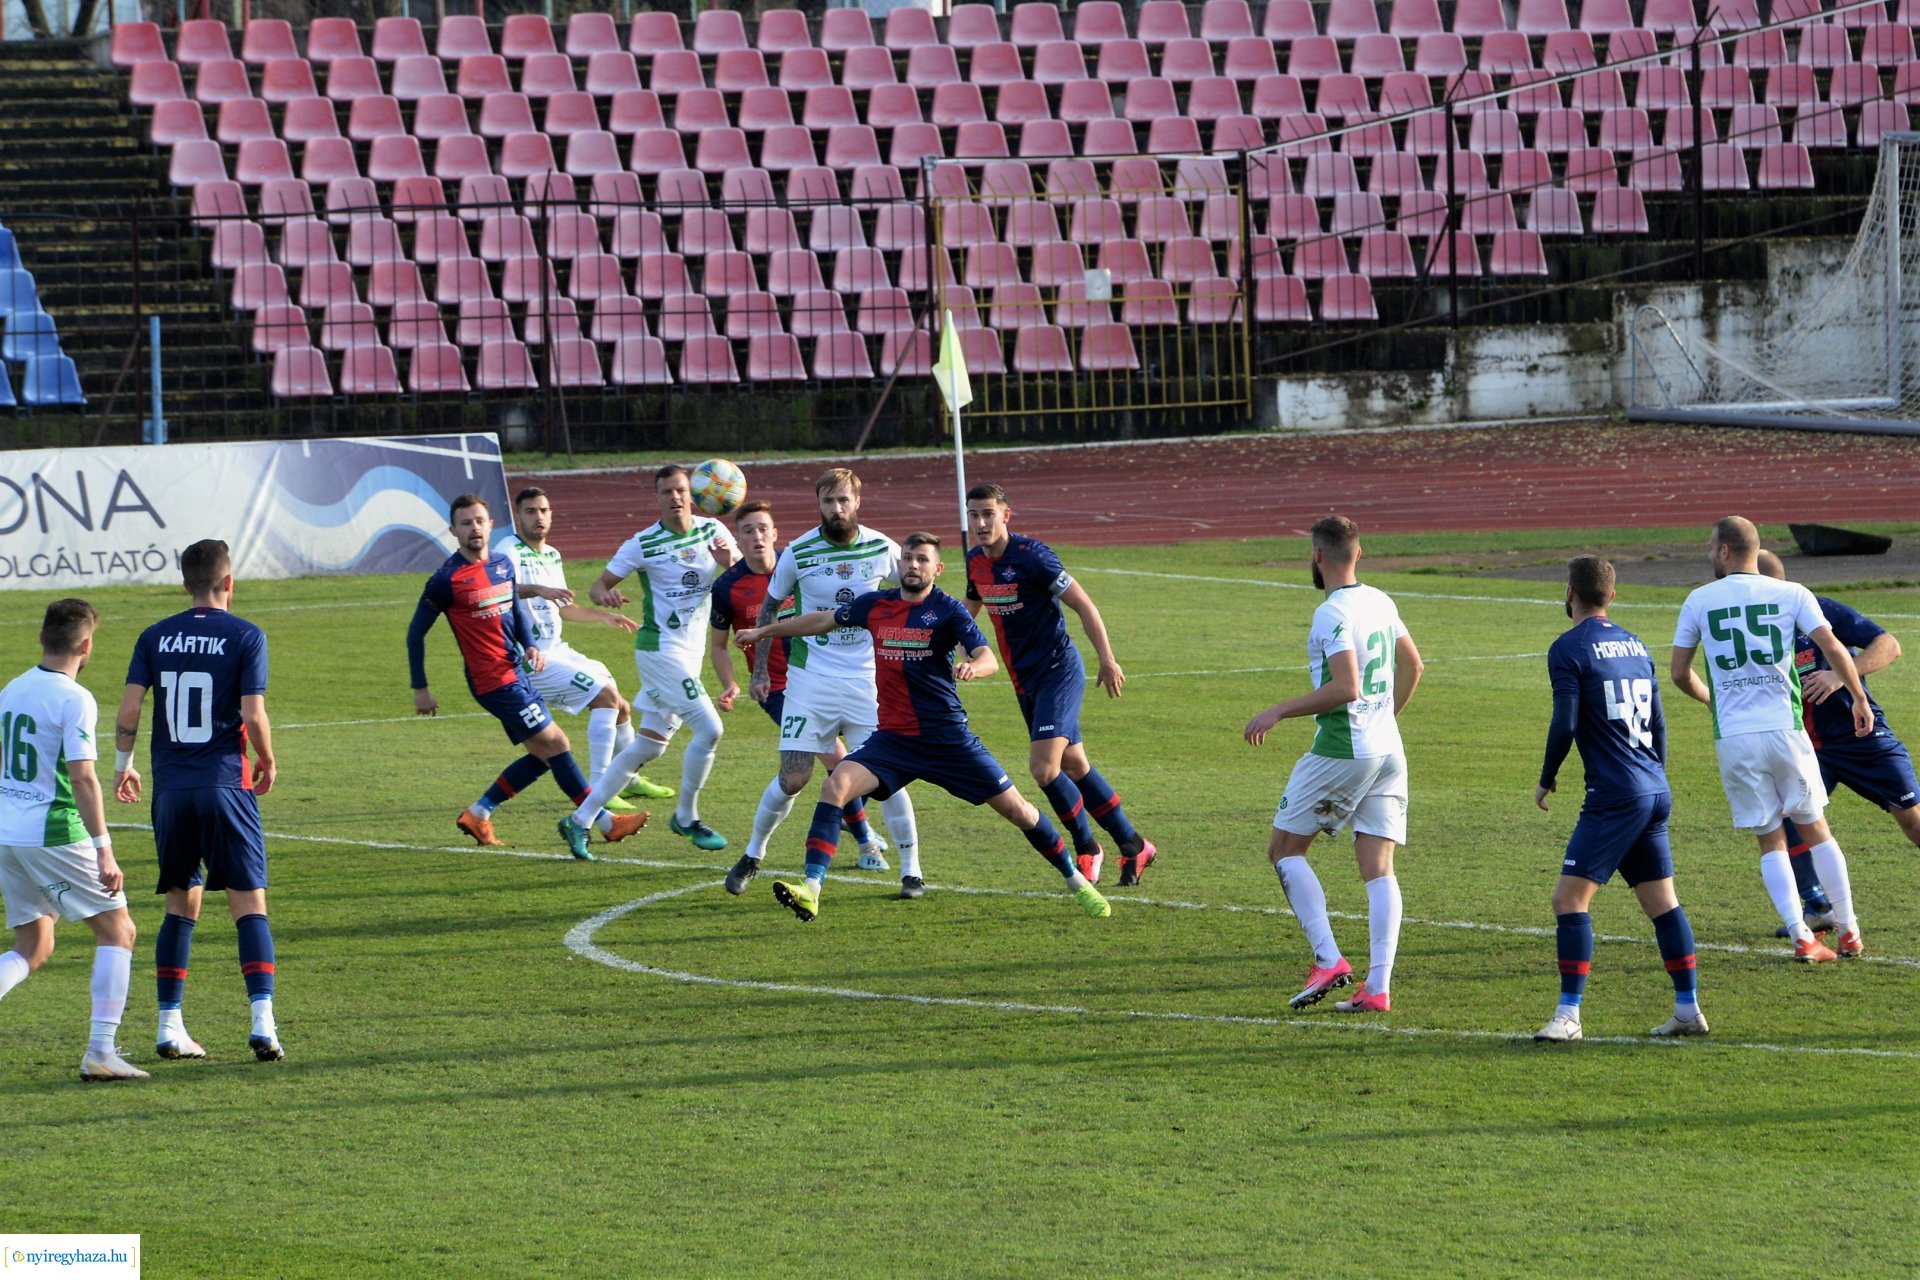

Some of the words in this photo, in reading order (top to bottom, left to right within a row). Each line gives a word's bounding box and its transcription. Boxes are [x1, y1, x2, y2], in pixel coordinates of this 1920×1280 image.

[1056, 576, 1068, 588] C
[158, 631, 227, 655] KÁRTIK
[877, 626, 933, 642] REVESZ
[1707, 603, 1784, 671] 55
[570, 671, 596, 692] 19
[160, 671, 213, 743] 10
[518, 702, 546, 729] 22
[1604, 678, 1653, 749] 48
[782, 715, 807, 738] 27
[2, 710, 38, 784] 16
